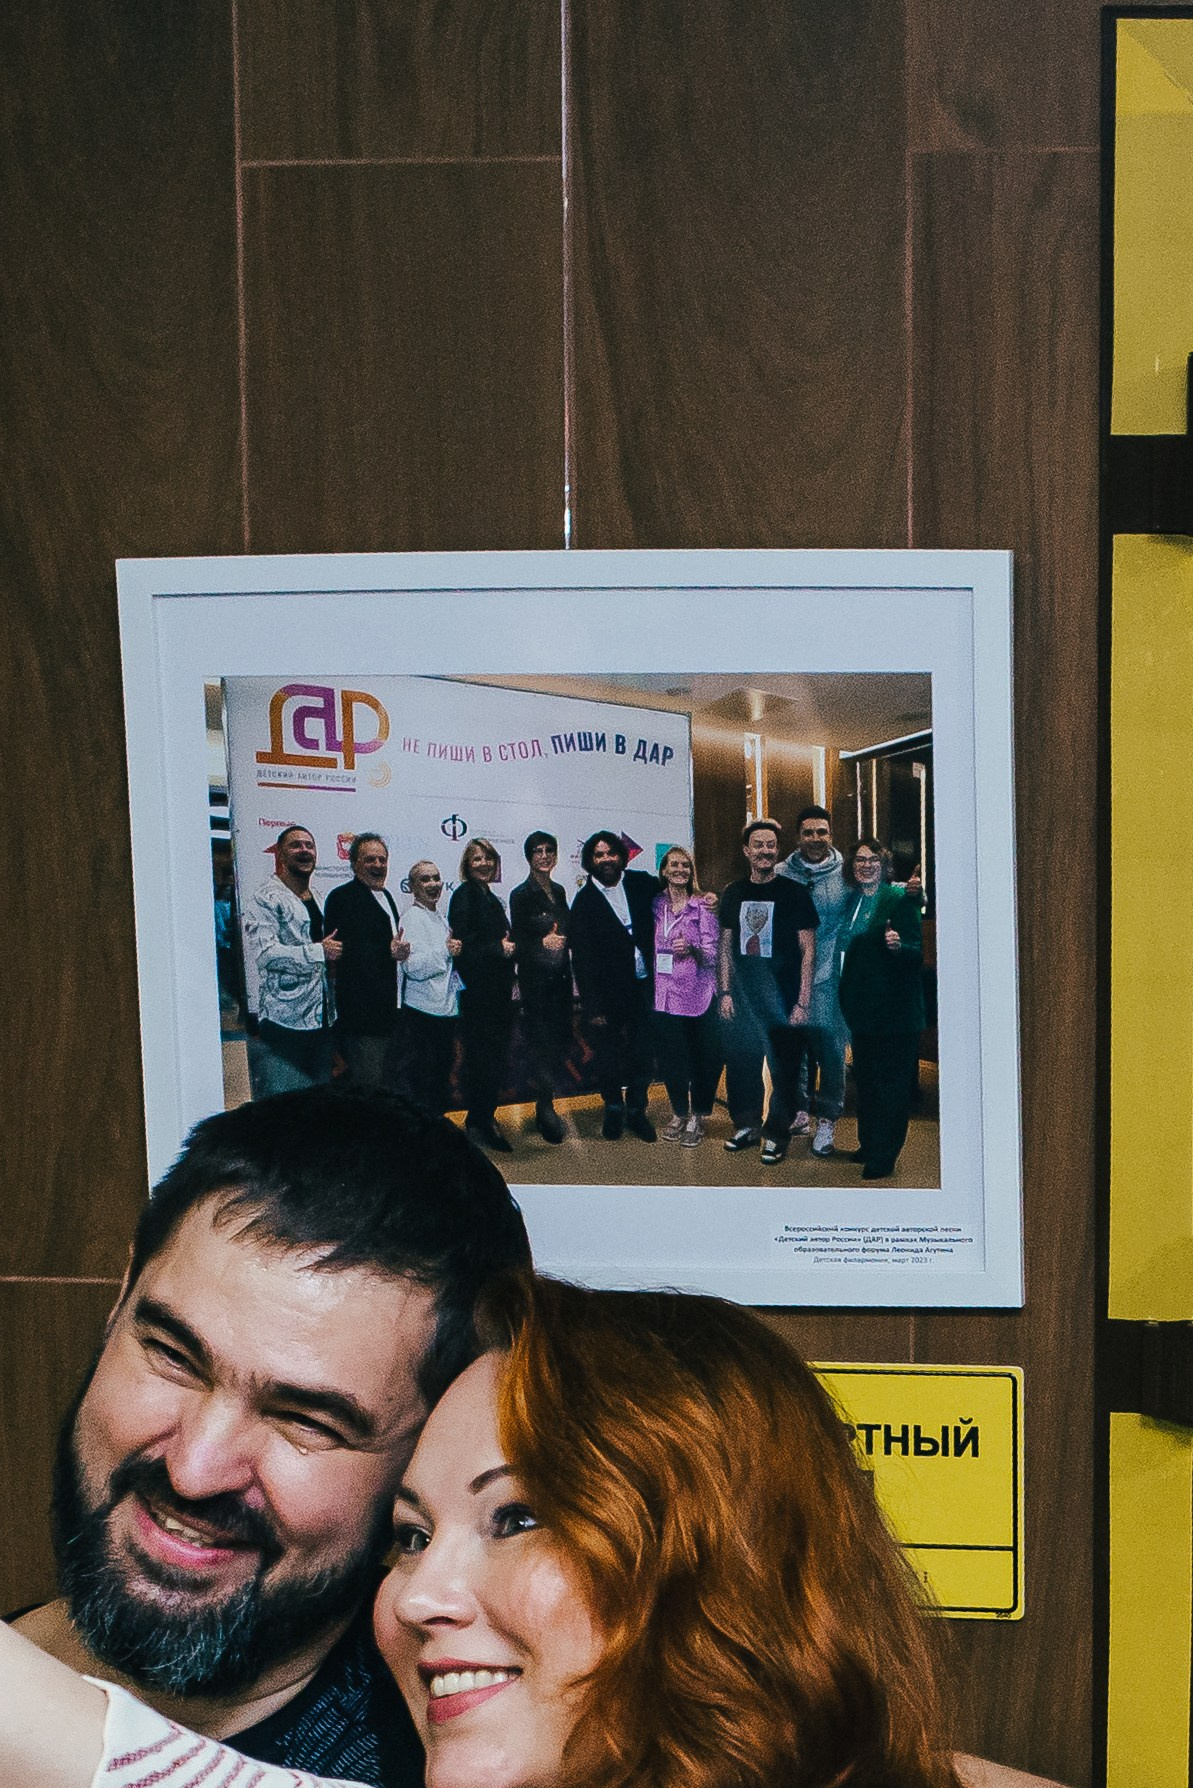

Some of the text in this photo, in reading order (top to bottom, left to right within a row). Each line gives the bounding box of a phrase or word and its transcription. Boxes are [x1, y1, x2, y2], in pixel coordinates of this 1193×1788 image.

[402, 736, 420, 754] НЕ
[426, 742, 475, 763] ПИШИ
[482, 745, 492, 763] В
[550, 731, 607, 755] ПИШИ
[614, 733, 626, 755] В
[632, 738, 675, 766] ДАР
[784, 1225, 839, 1233] Всероссийский
[870, 1226, 900, 1234] детской
[901, 1226, 939, 1235] авторской
[862, 1236, 884, 1244] (ДАР)
[793, 1245, 860, 1253] образовательного
[861, 1246, 890, 1254] форума
[891, 1246, 924, 1254] Леонида
